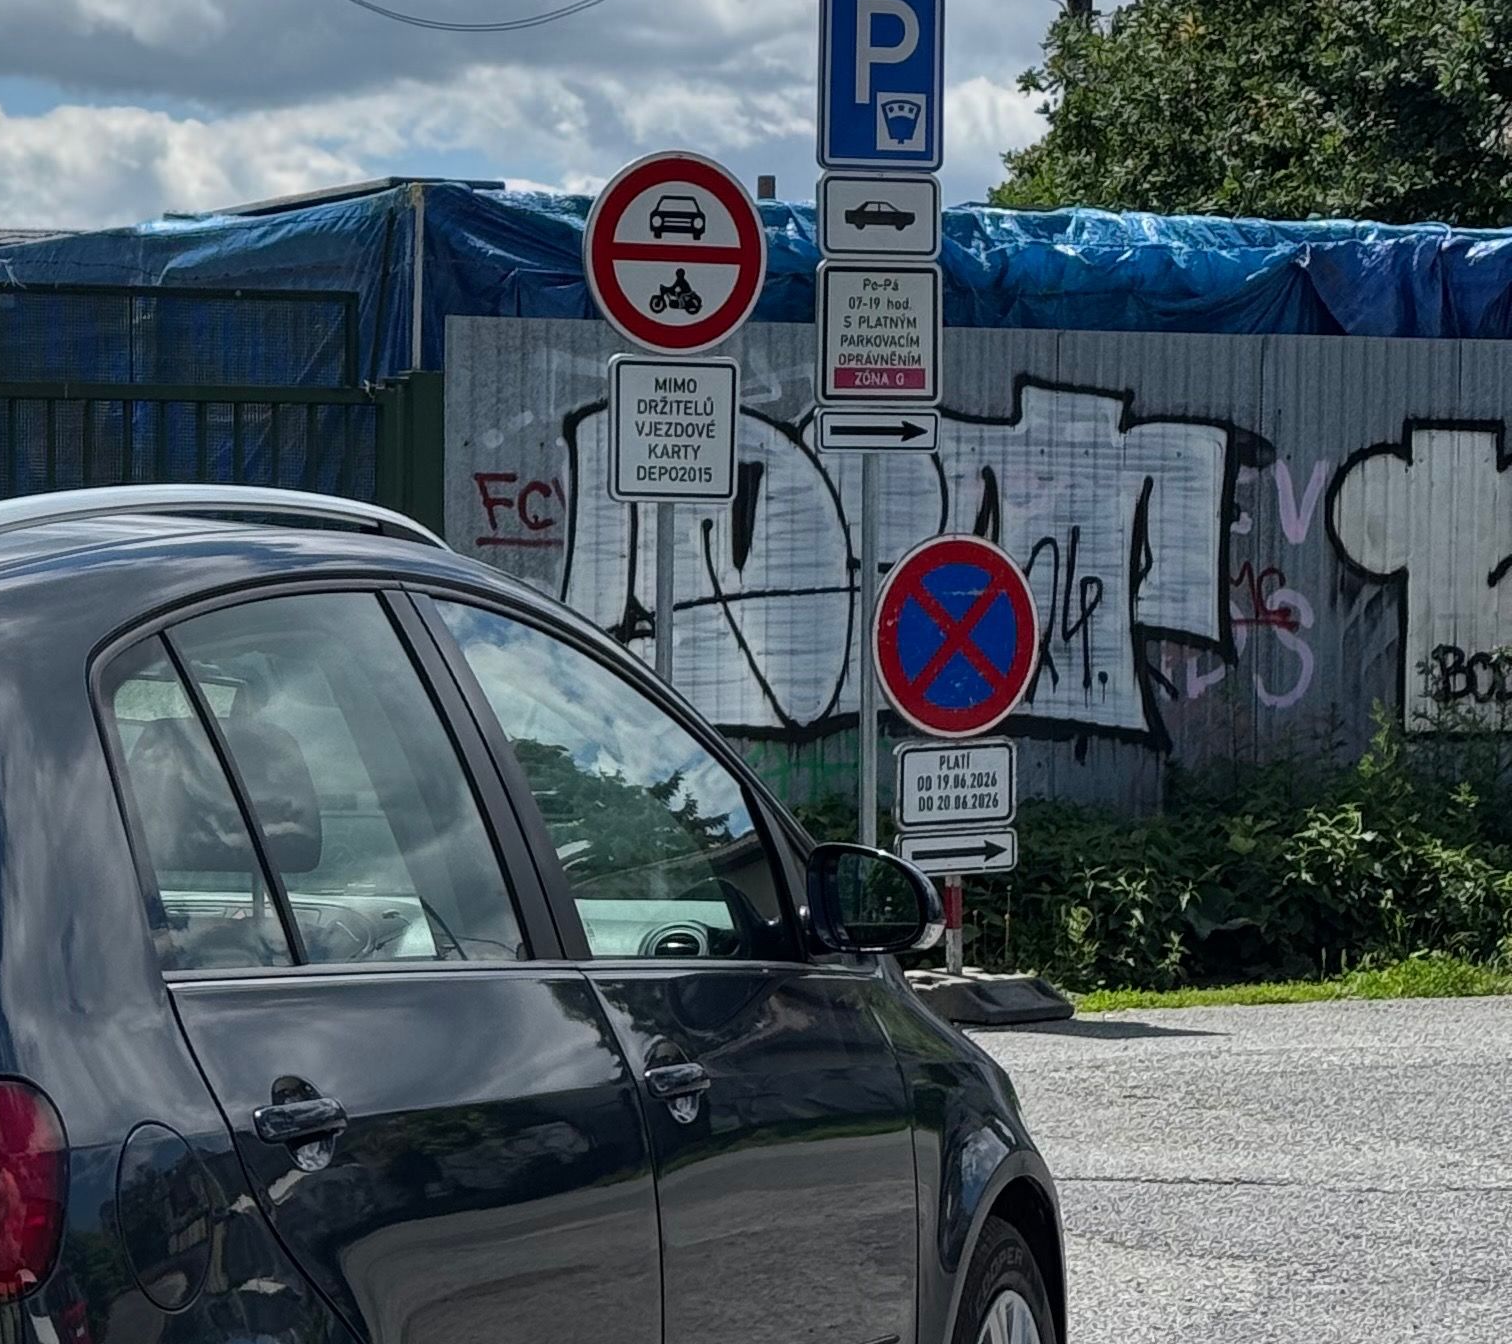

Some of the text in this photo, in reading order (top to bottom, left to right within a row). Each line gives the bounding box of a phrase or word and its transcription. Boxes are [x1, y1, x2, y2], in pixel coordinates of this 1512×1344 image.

[848, 297, 912, 310] 07-19 hod.
[843, 313, 917, 329] S PLATNÝM
[840, 332, 920, 348] PARKOVACÍM
[838, 351, 921, 366] OPRÁVNĚNÍM
[654, 377, 698, 394] MIMO
[854, 370, 890, 386] ZÓNA
[637, 396, 714, 416] DRŽITELŮ
[635, 419, 716, 439] VJEZDOVÉ
[648, 443, 702, 460] KARTY
[636, 465, 713, 483] DEPO2015
[939, 751, 972, 771] PLATÍ
[917, 771, 998, 792] OD 19.06.2026
[918, 796, 934, 812] DO
